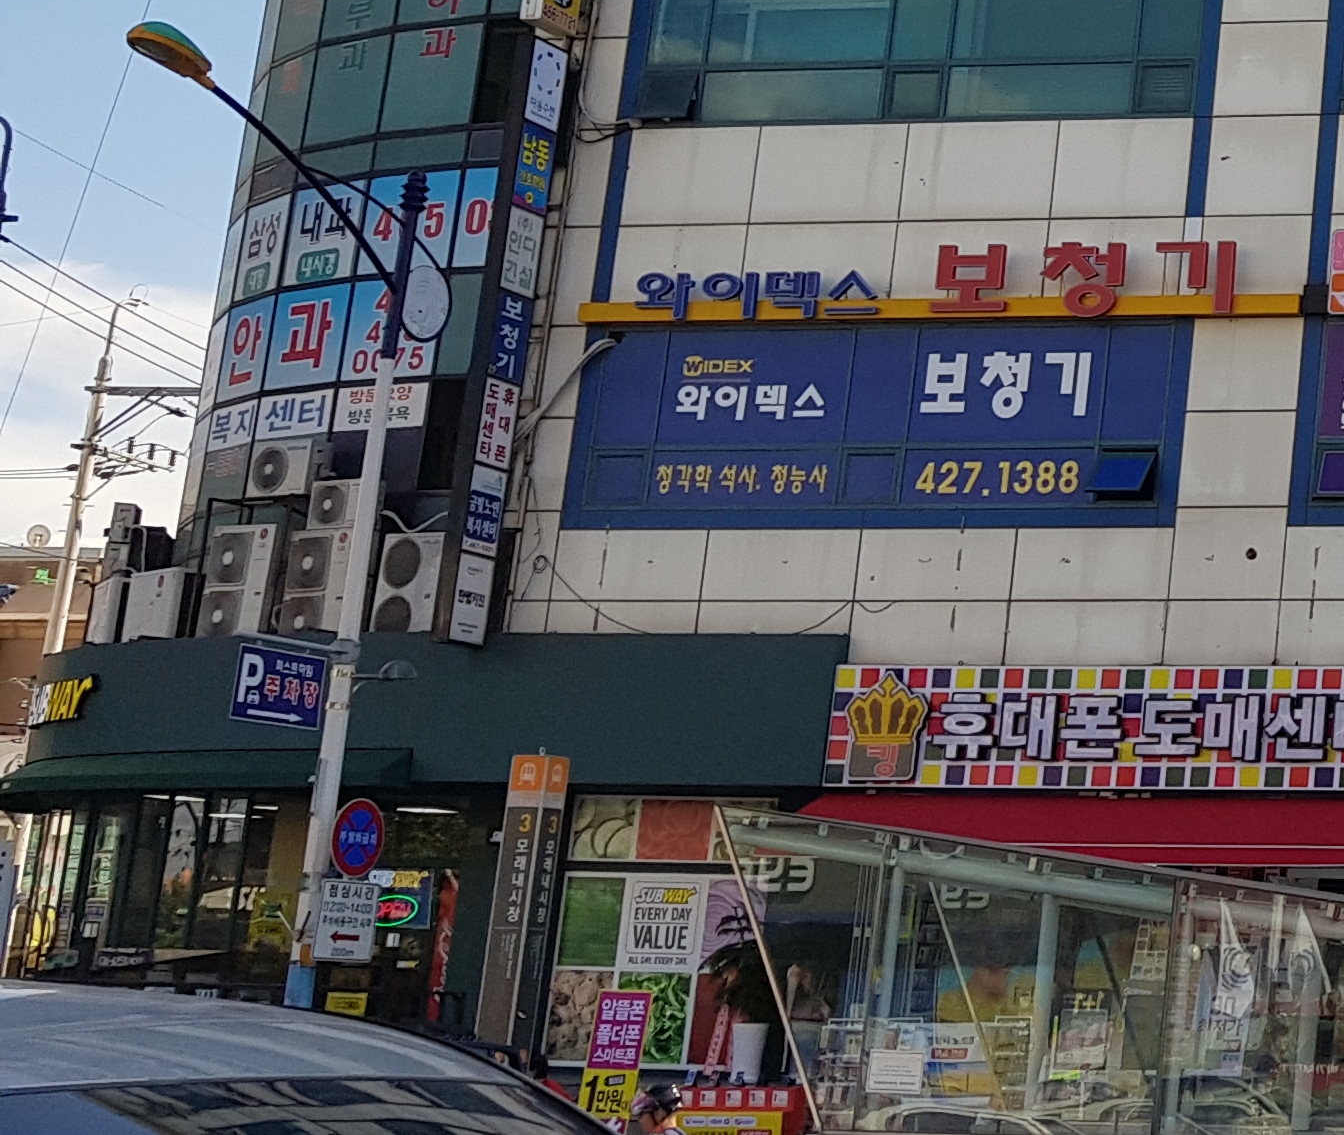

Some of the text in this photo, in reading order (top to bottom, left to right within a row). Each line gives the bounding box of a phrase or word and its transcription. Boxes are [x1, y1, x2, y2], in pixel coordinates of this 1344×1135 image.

[634, 240, 1239, 321] 와이덱스 보청기
[228, 299, 334, 388] 안과
[682, 355, 754, 377] WIDEX
[674, 382, 826, 421] 와이덱스
[918, 351, 1093, 420] 보청기
[264, 394, 327, 433] 센터
[914, 459, 1080, 498] 427.1388
[263, 673, 320, 710] 주차장
[328, 883, 375, 899] 점심시간
[634, 885, 697, 905] SUBWAY
[633, 906, 692, 922] EVERY DAY
[633, 924, 689, 951] VALUE
